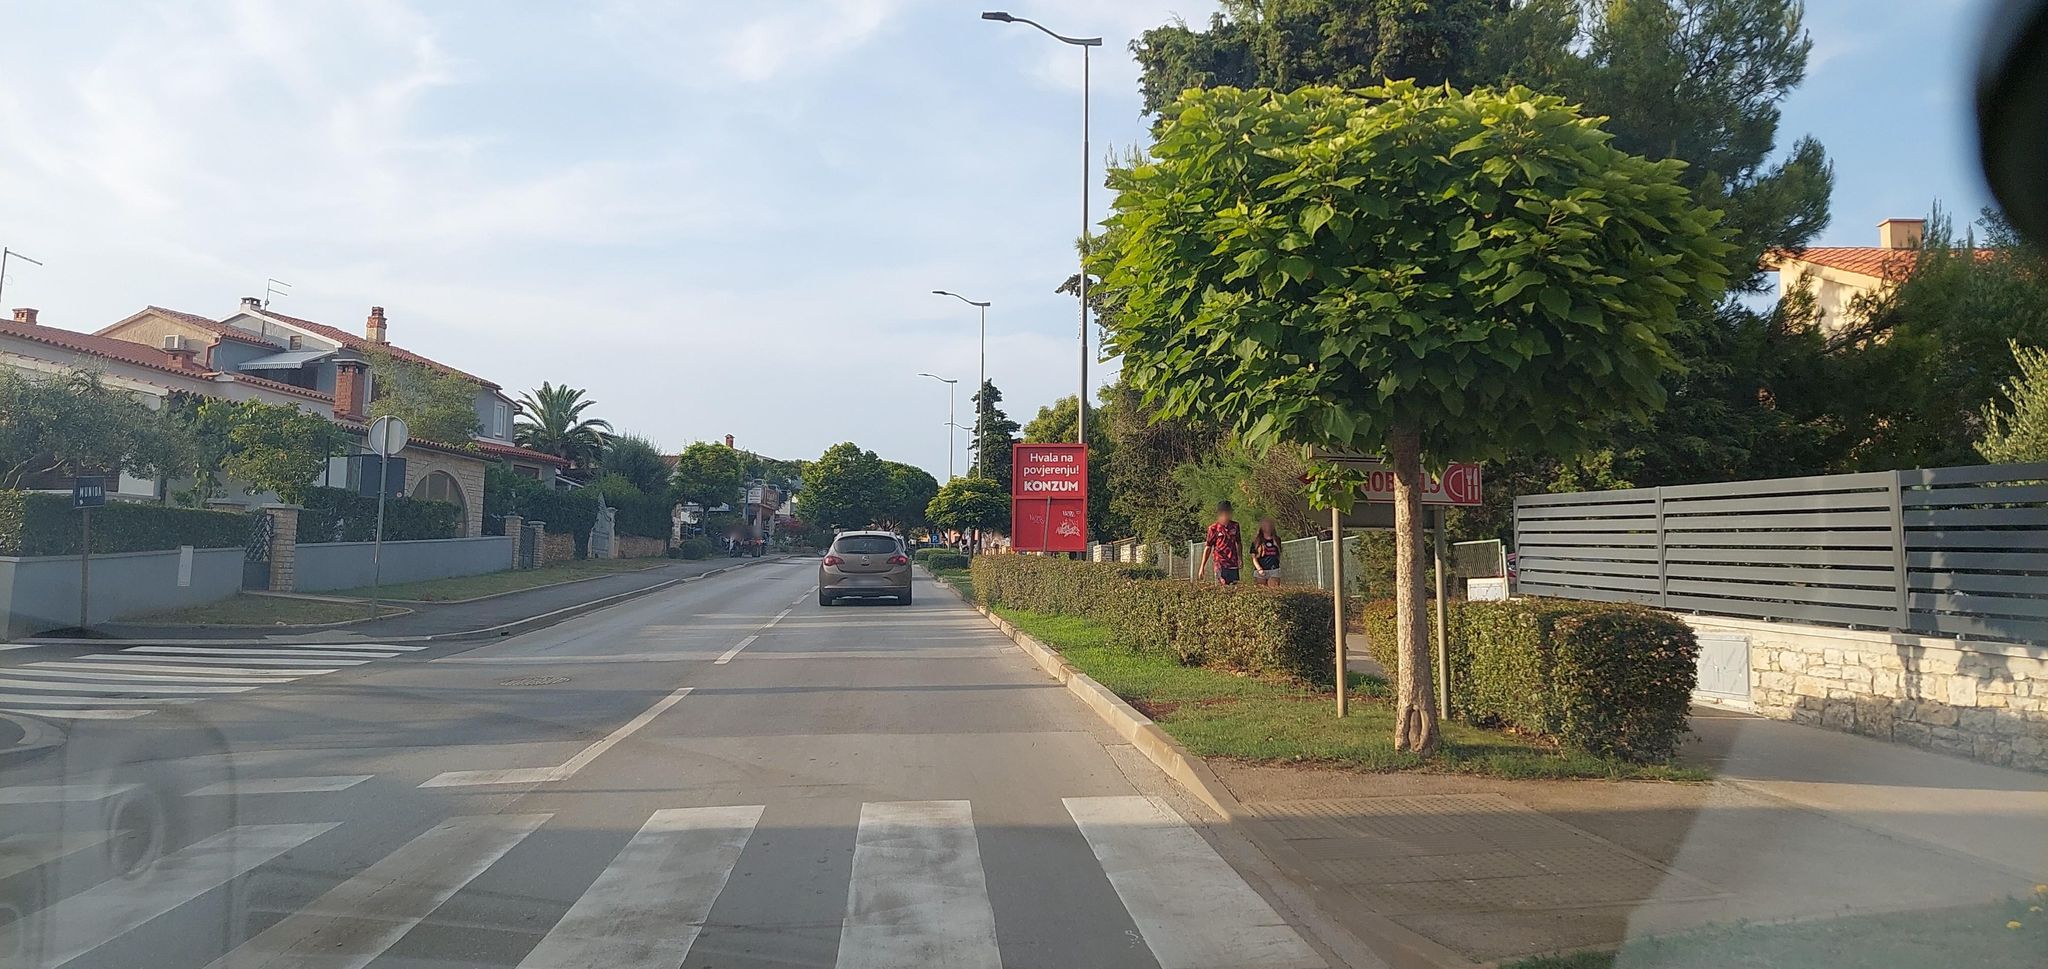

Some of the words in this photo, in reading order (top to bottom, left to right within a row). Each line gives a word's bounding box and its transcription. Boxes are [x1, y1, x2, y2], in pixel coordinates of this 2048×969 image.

[1030, 453, 1058, 462] Hvala
[1024, 465, 1079, 477] povjerenju!
[1024, 481, 1079, 492] KONZUM
